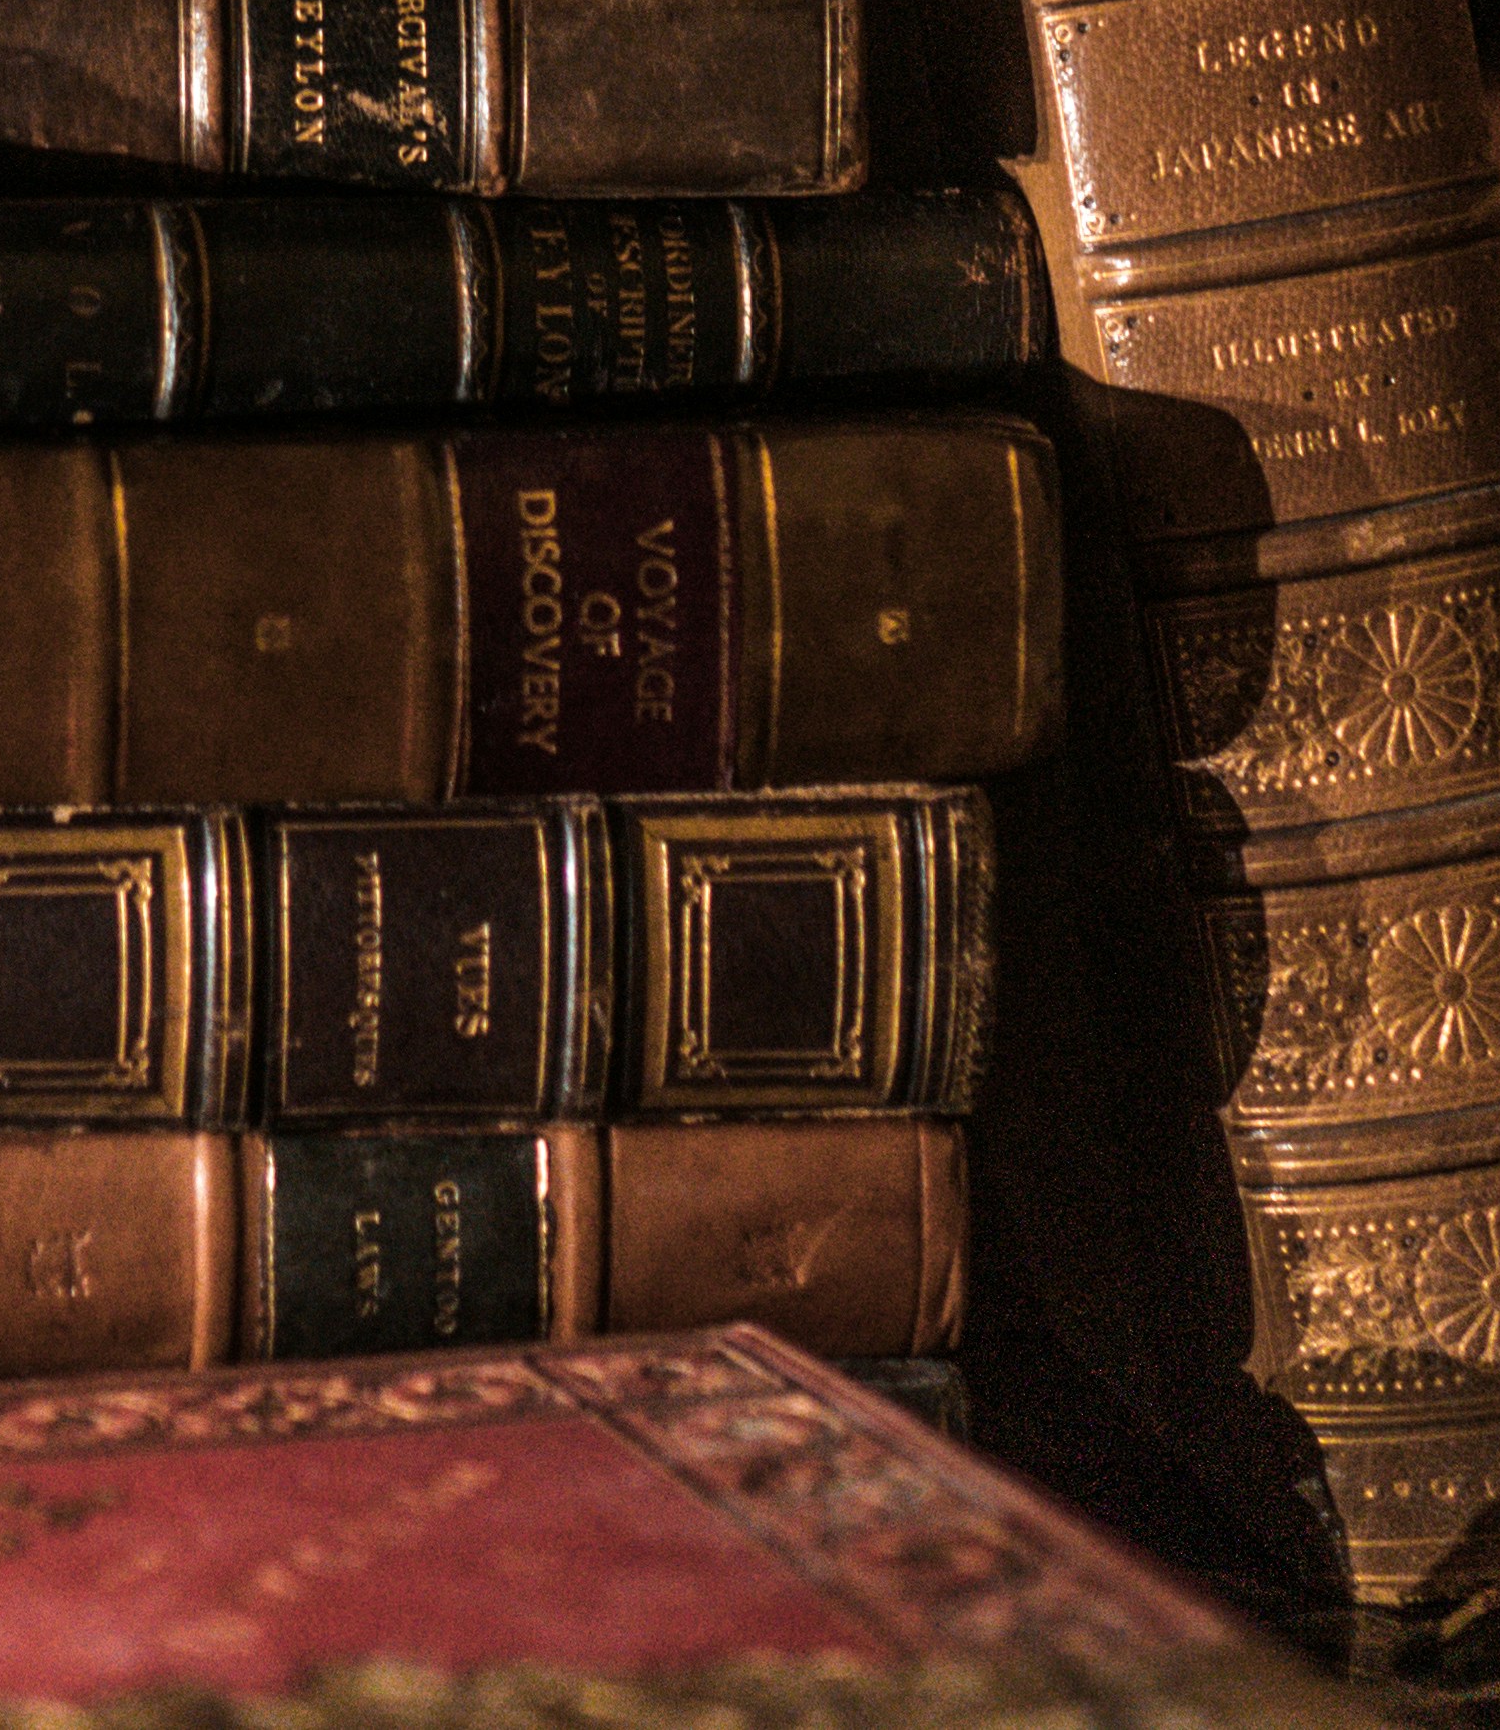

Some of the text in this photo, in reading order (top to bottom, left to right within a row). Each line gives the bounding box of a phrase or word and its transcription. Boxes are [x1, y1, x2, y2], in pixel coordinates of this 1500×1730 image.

[1196, 14, 1380, 73] LEGEND
[1282, 76, 1322, 109] IN
[1151, 100, 1446, 182] JAPANESE ART
[1212, 304, 1459, 372] ILLUSTRATED
[516, 488, 563, 756] DISCOVERY
[579, 590, 622, 658] OF
[635, 518, 679, 724] VOYAGE
[352, 1210, 381, 1319] LAWS
[432, 1179, 462, 1336] GENTOO
